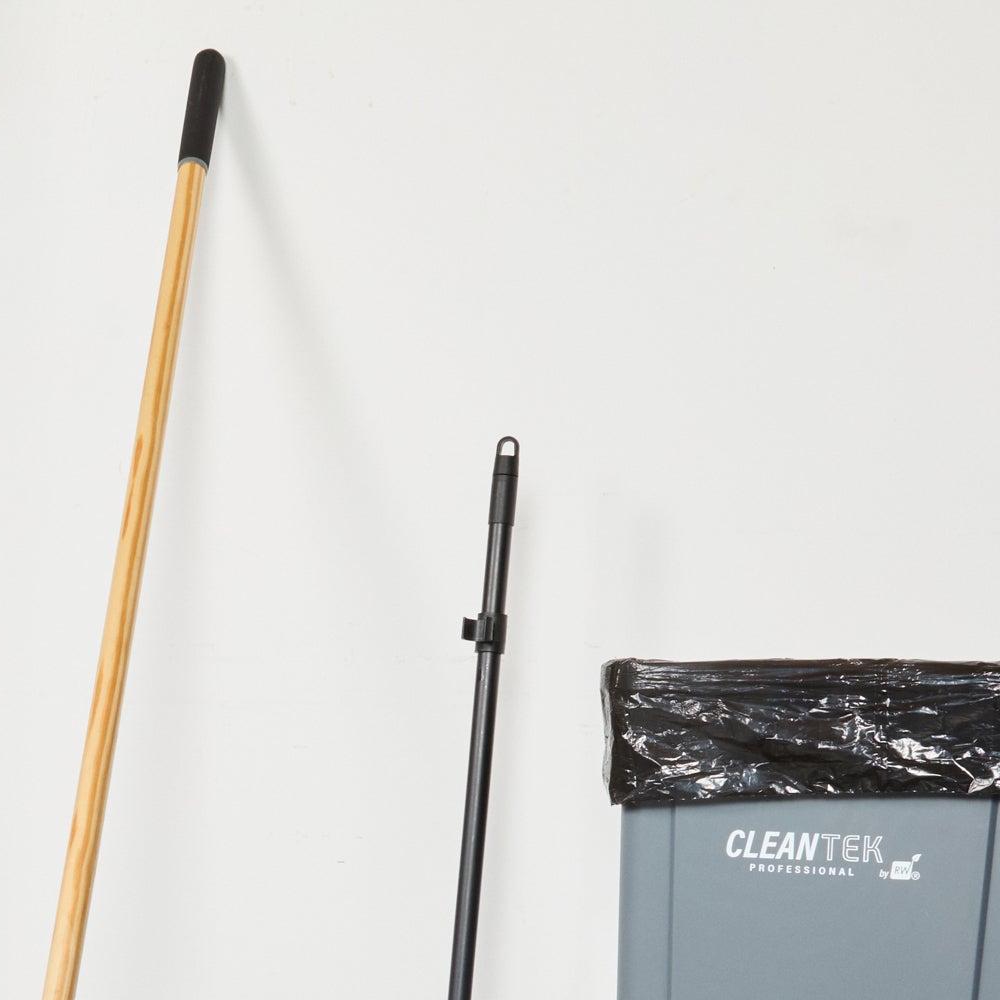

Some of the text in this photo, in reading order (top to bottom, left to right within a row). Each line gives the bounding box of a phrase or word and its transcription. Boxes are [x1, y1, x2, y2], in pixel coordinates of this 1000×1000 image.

[725, 829, 884, 863] CLEANTEK
[749, 863, 855, 876] PROFESSIONAL
[879, 868, 889, 879] by
